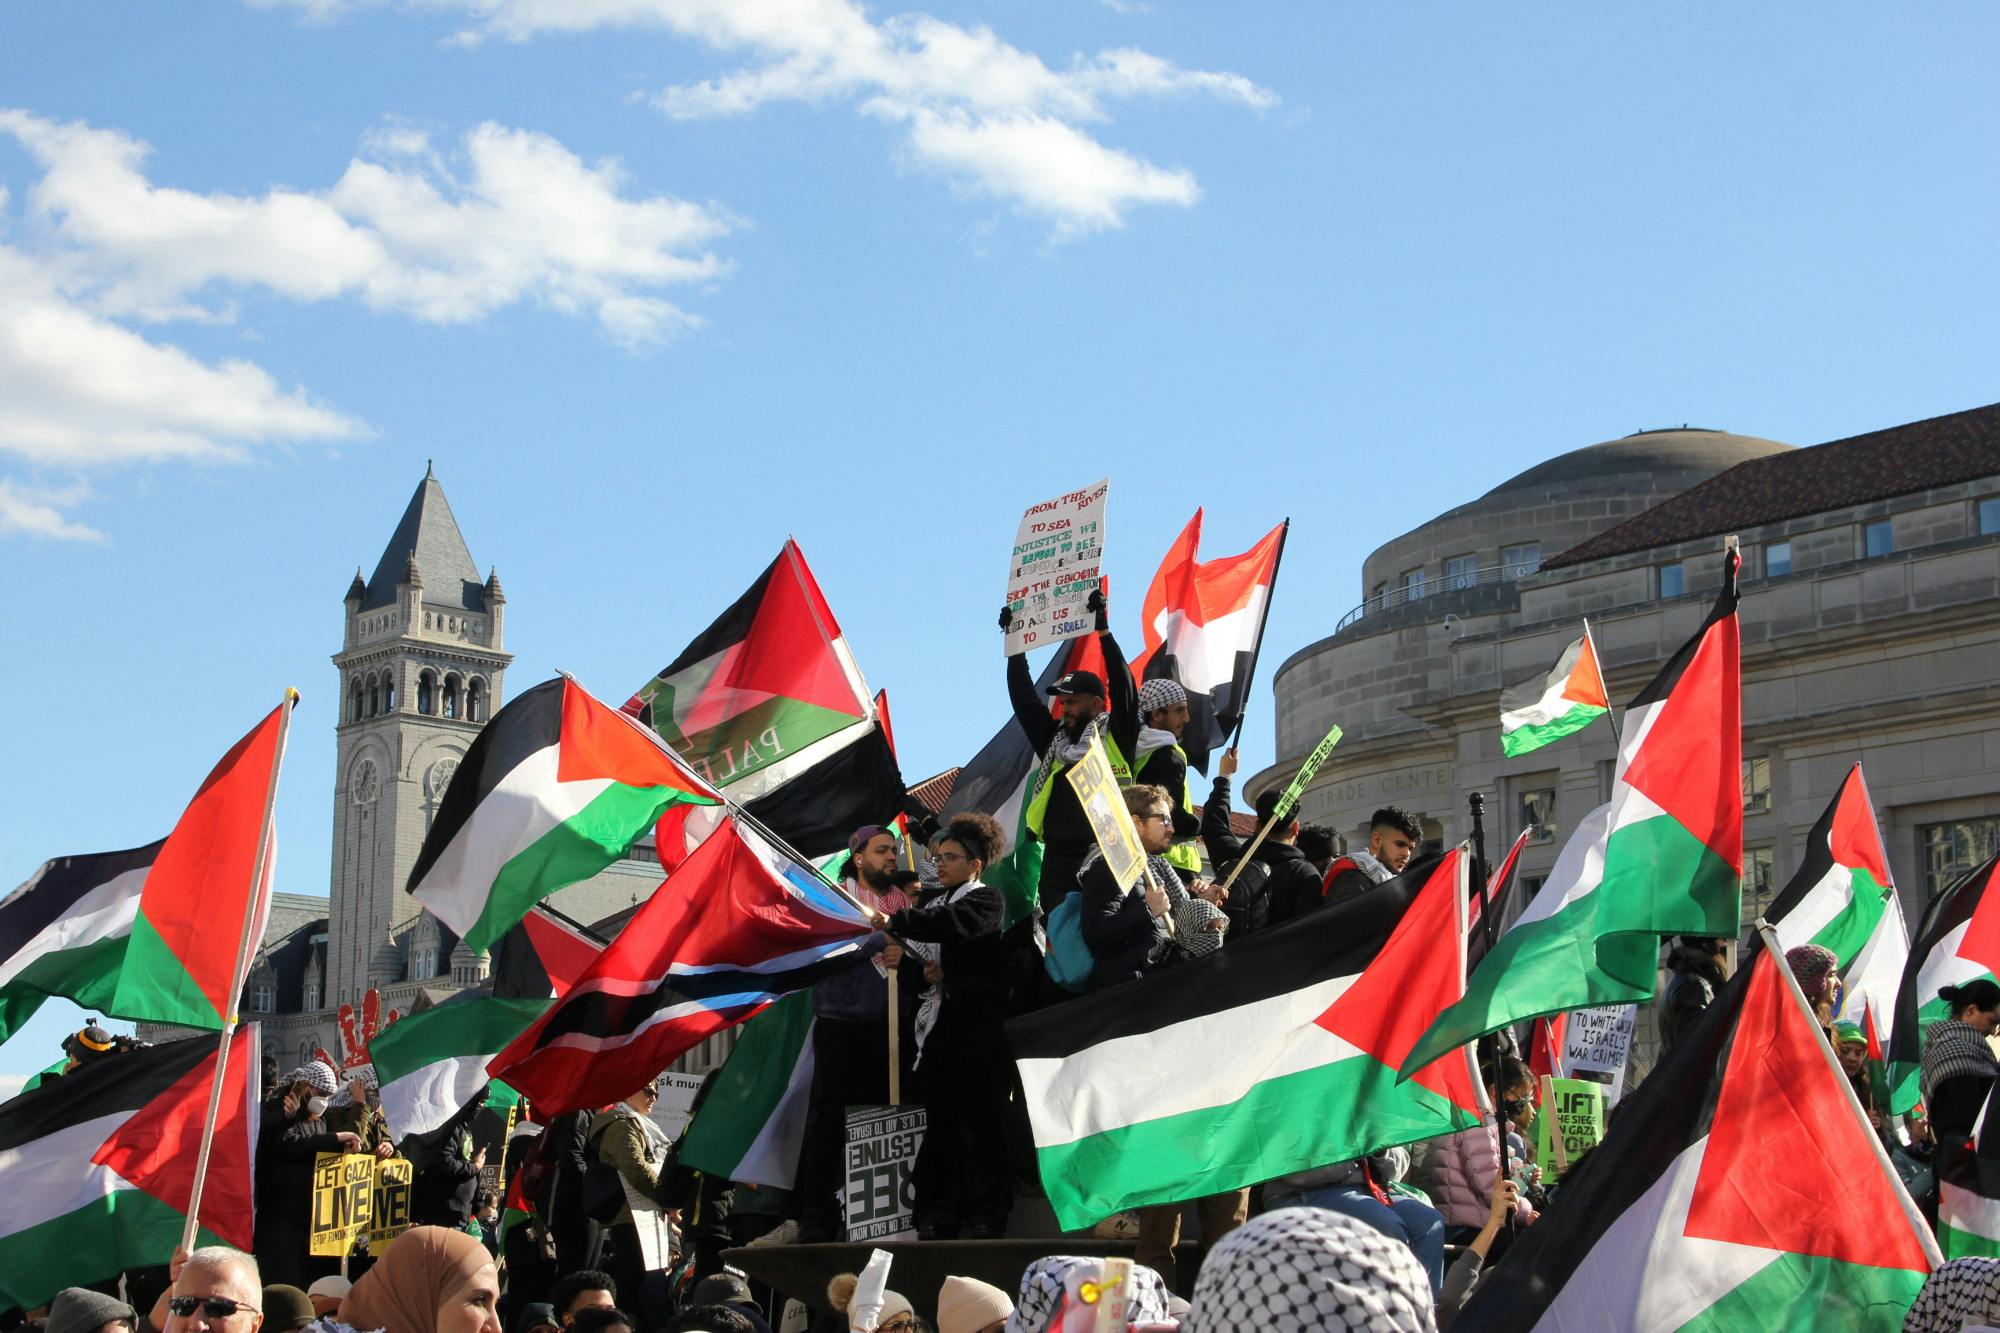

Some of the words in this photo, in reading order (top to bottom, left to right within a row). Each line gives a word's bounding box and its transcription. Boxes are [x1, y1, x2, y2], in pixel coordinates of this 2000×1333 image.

[1023, 501, 1058, 518] FROM
[1061, 489, 1087, 505] THE
[1077, 484, 1108, 511] RIVER
[1031, 522, 1046, 533] TO
[1047, 518, 1071, 532] SEA
[1080, 521, 1097, 534] WE
[1022, 547, 1056, 566] REFUSE
[1060, 541, 1072, 554] TO
[1075, 537, 1096, 552] SEE
[1007, 586, 1029, 603] STOP
[1031, 578, 1050, 593] THE
[1052, 608, 1069, 621] US
[1023, 632, 1036, 645] TO
[1051, 619, 1088, 636] ISRAEL
[1071, 754, 1104, 801] END
[1320, 783, 1366, 808] TRADE
[1576, 1012, 1587, 1027] TO
[1590, 1015, 1616, 1031] WHITE
[1582, 1029, 1626, 1050] ISRAEL'S
[1569, 1044, 1588, 1060] WAR
[1554, 1092, 1595, 1114] LIFT
[886, 1118, 898, 1133] AID
[900, 1114, 915, 1129] U.S.
[917, 1111, 927, 1126] LL
[1558, 1114, 1569, 1123] HE
[848, 1124, 872, 1141] ISRAEL
[874, 1122, 884, 1136] TO
[849, 1132, 918, 1170] ESTINE!
[316, 1166, 341, 1189] LET
[345, 1159, 372, 1184] GAZA
[381, 1164, 410, 1187] GAZA
[480, 1167, 495, 1176] ND
[849, 1162, 916, 1225] REE
[314, 1180, 372, 1233] LIVE!
[370, 1184, 409, 1231] IVE!
[870, 1221, 887, 1237] GAZA
[888, 1219, 898, 1233] ON
[313, 1232, 327, 1246] STOP
